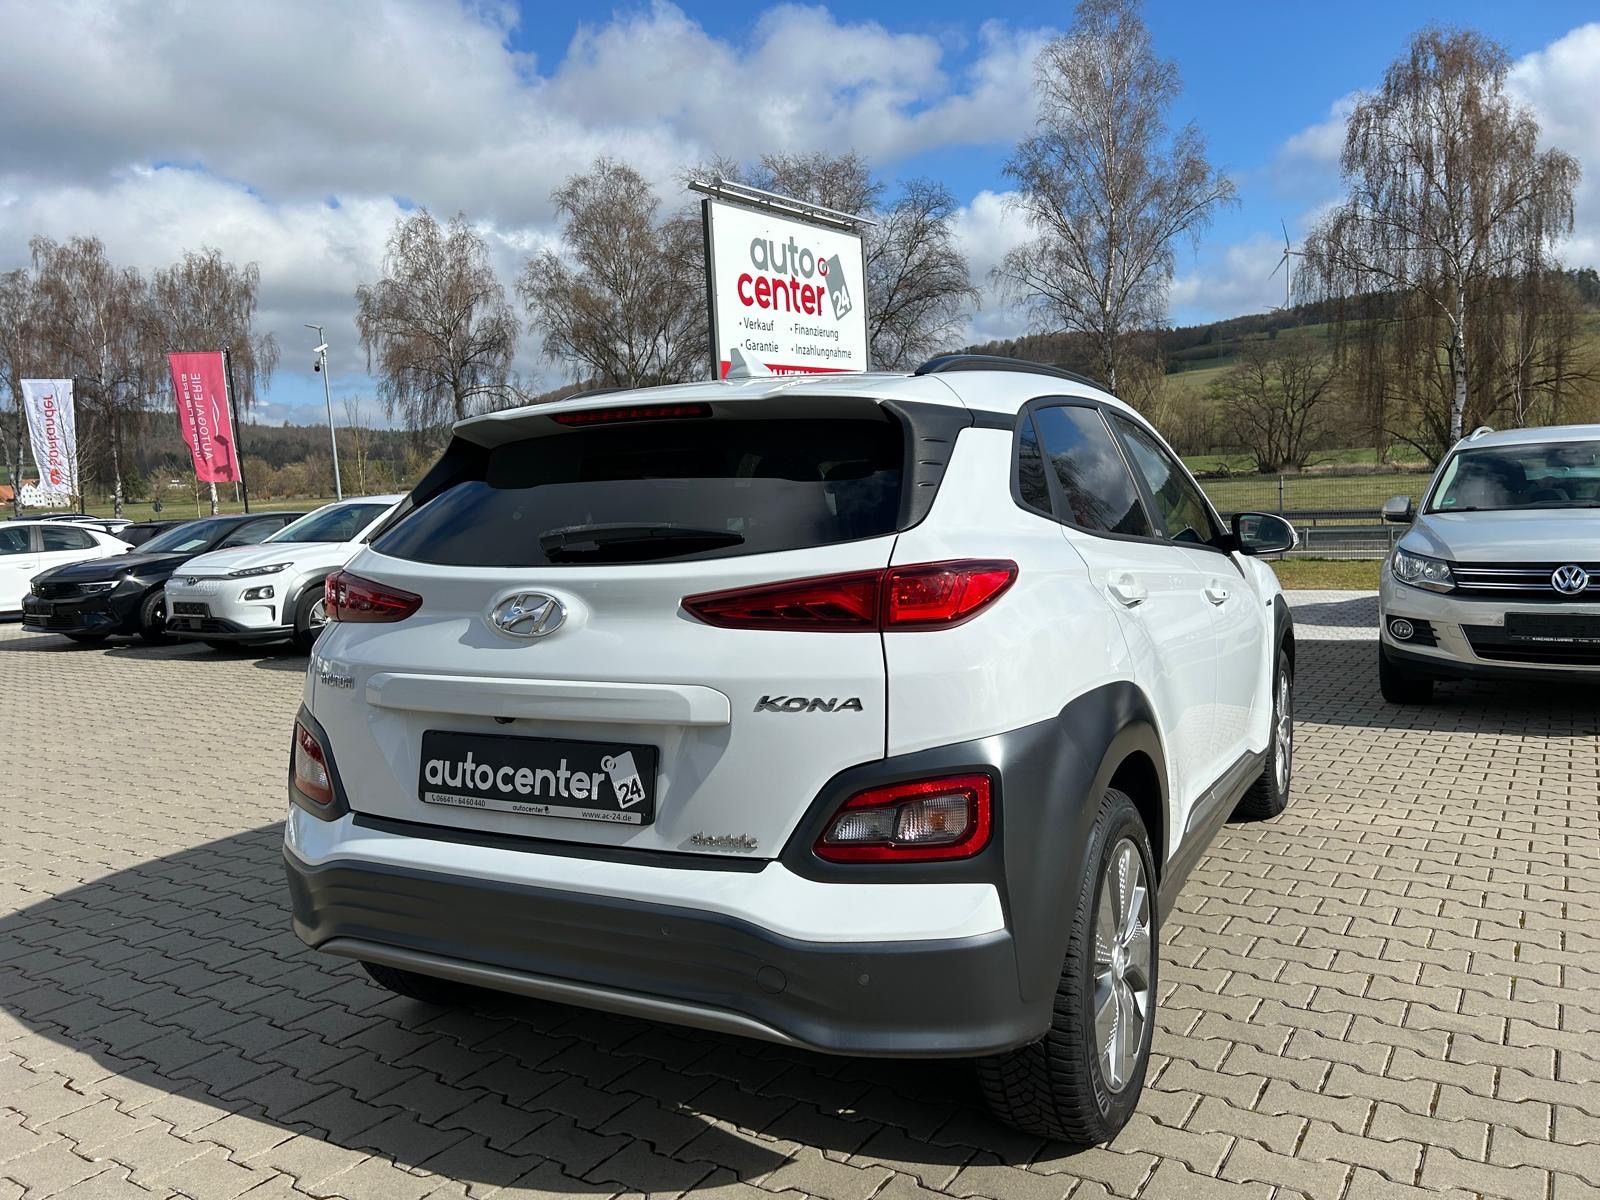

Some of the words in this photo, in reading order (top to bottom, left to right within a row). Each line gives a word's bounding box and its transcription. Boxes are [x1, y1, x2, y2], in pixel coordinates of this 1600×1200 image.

[749, 236, 815, 279] auto
[737, 273, 825, 316] center
[832, 285, 851, 316] 24
[743, 317, 774, 332] Verkauf
[794, 323, 839, 341] Finanzierung
[745, 338, 779, 353] Garantie
[795, 344, 852, 359] Inzahlungnahme
[753, 695, 864, 713] KONA
[424, 751, 605, 801] autocenter
[618, 778, 642, 806] 24
[581, 811, 632, 822] www.ac-24.de
